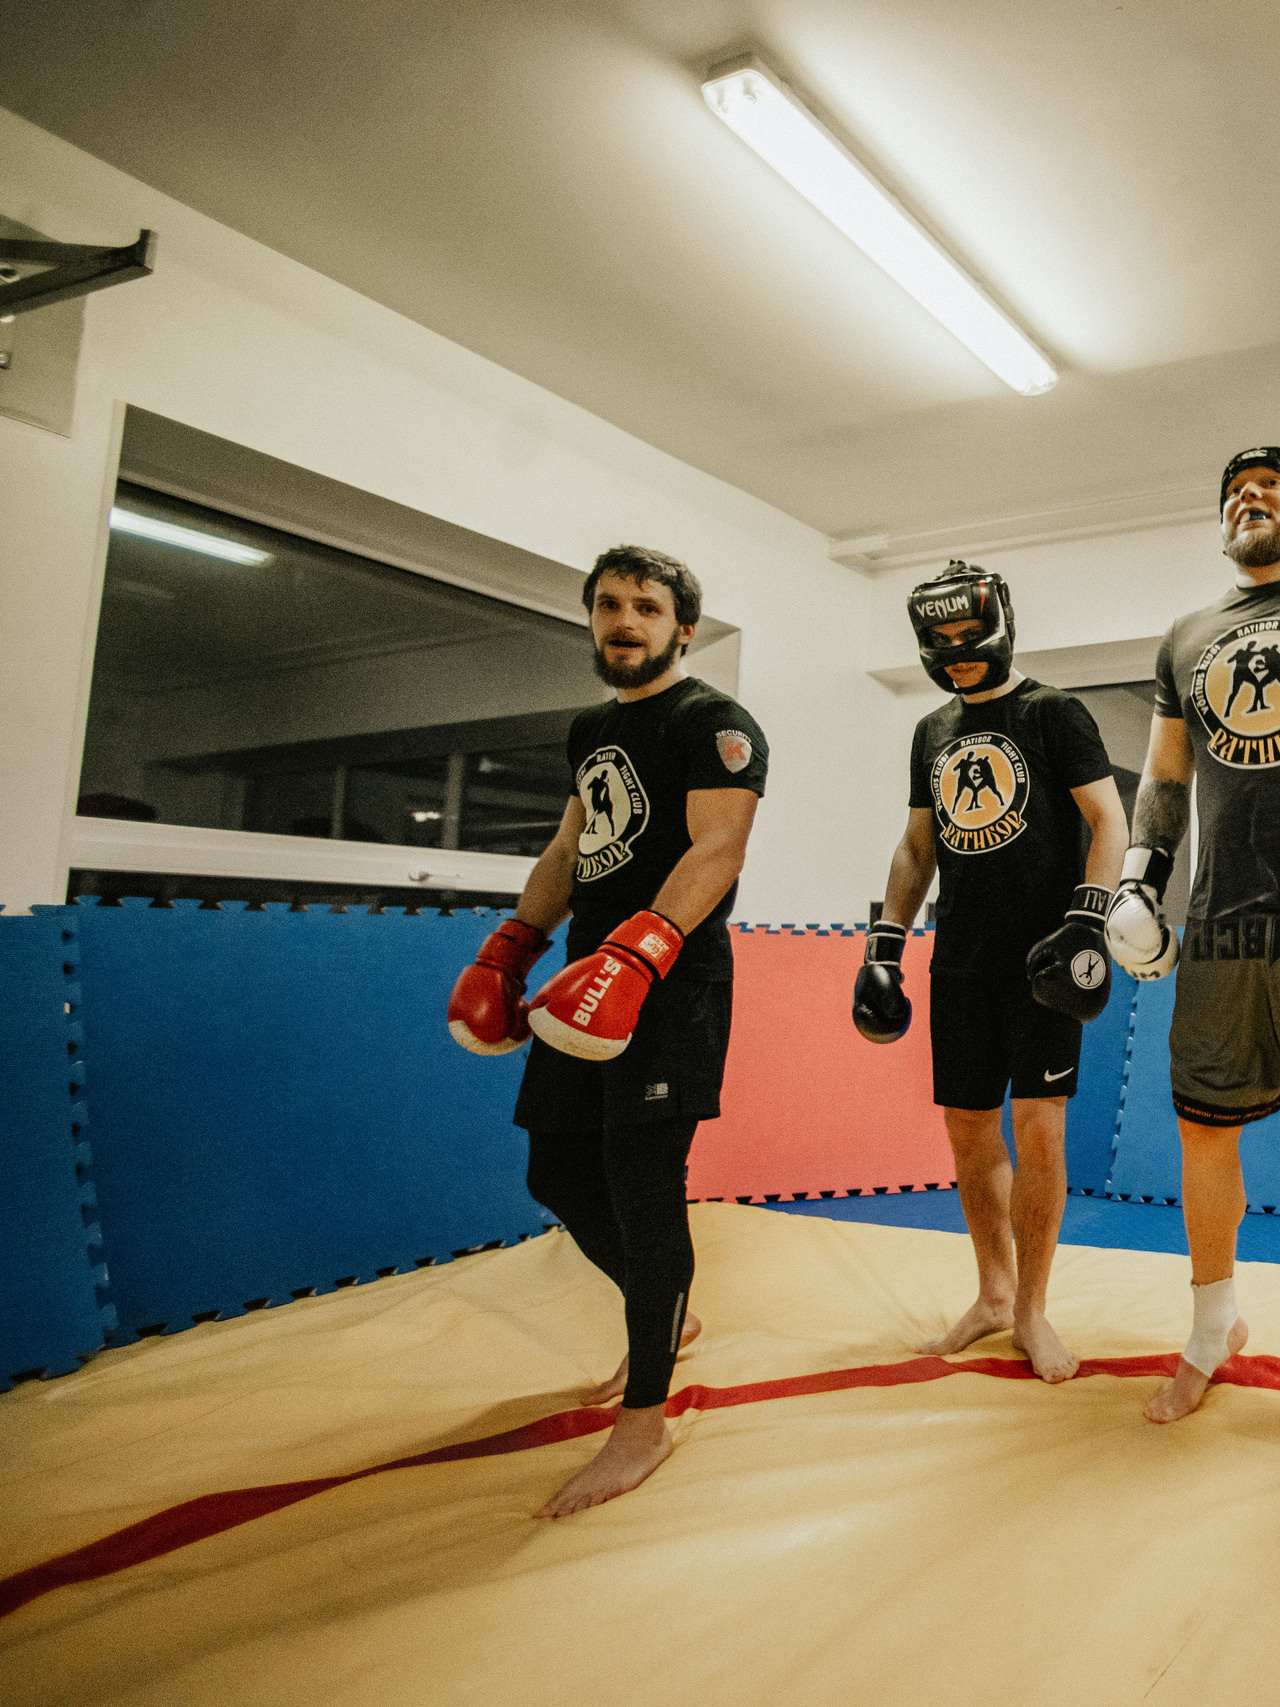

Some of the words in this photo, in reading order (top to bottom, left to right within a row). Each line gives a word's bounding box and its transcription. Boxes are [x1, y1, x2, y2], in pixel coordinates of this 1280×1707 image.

[916, 595, 969, 619] VENUM
[1236, 621, 1279, 638] RATIBOR
[960, 736, 992, 747] RATIBOR
[1001, 741, 1020, 765] FIGHT
[1014, 762, 1026, 784] CLUB
[620, 764, 637, 790] FIGHT
[630, 789, 643, 815] CLUB
[572, 955, 622, 1027] BULL'S
